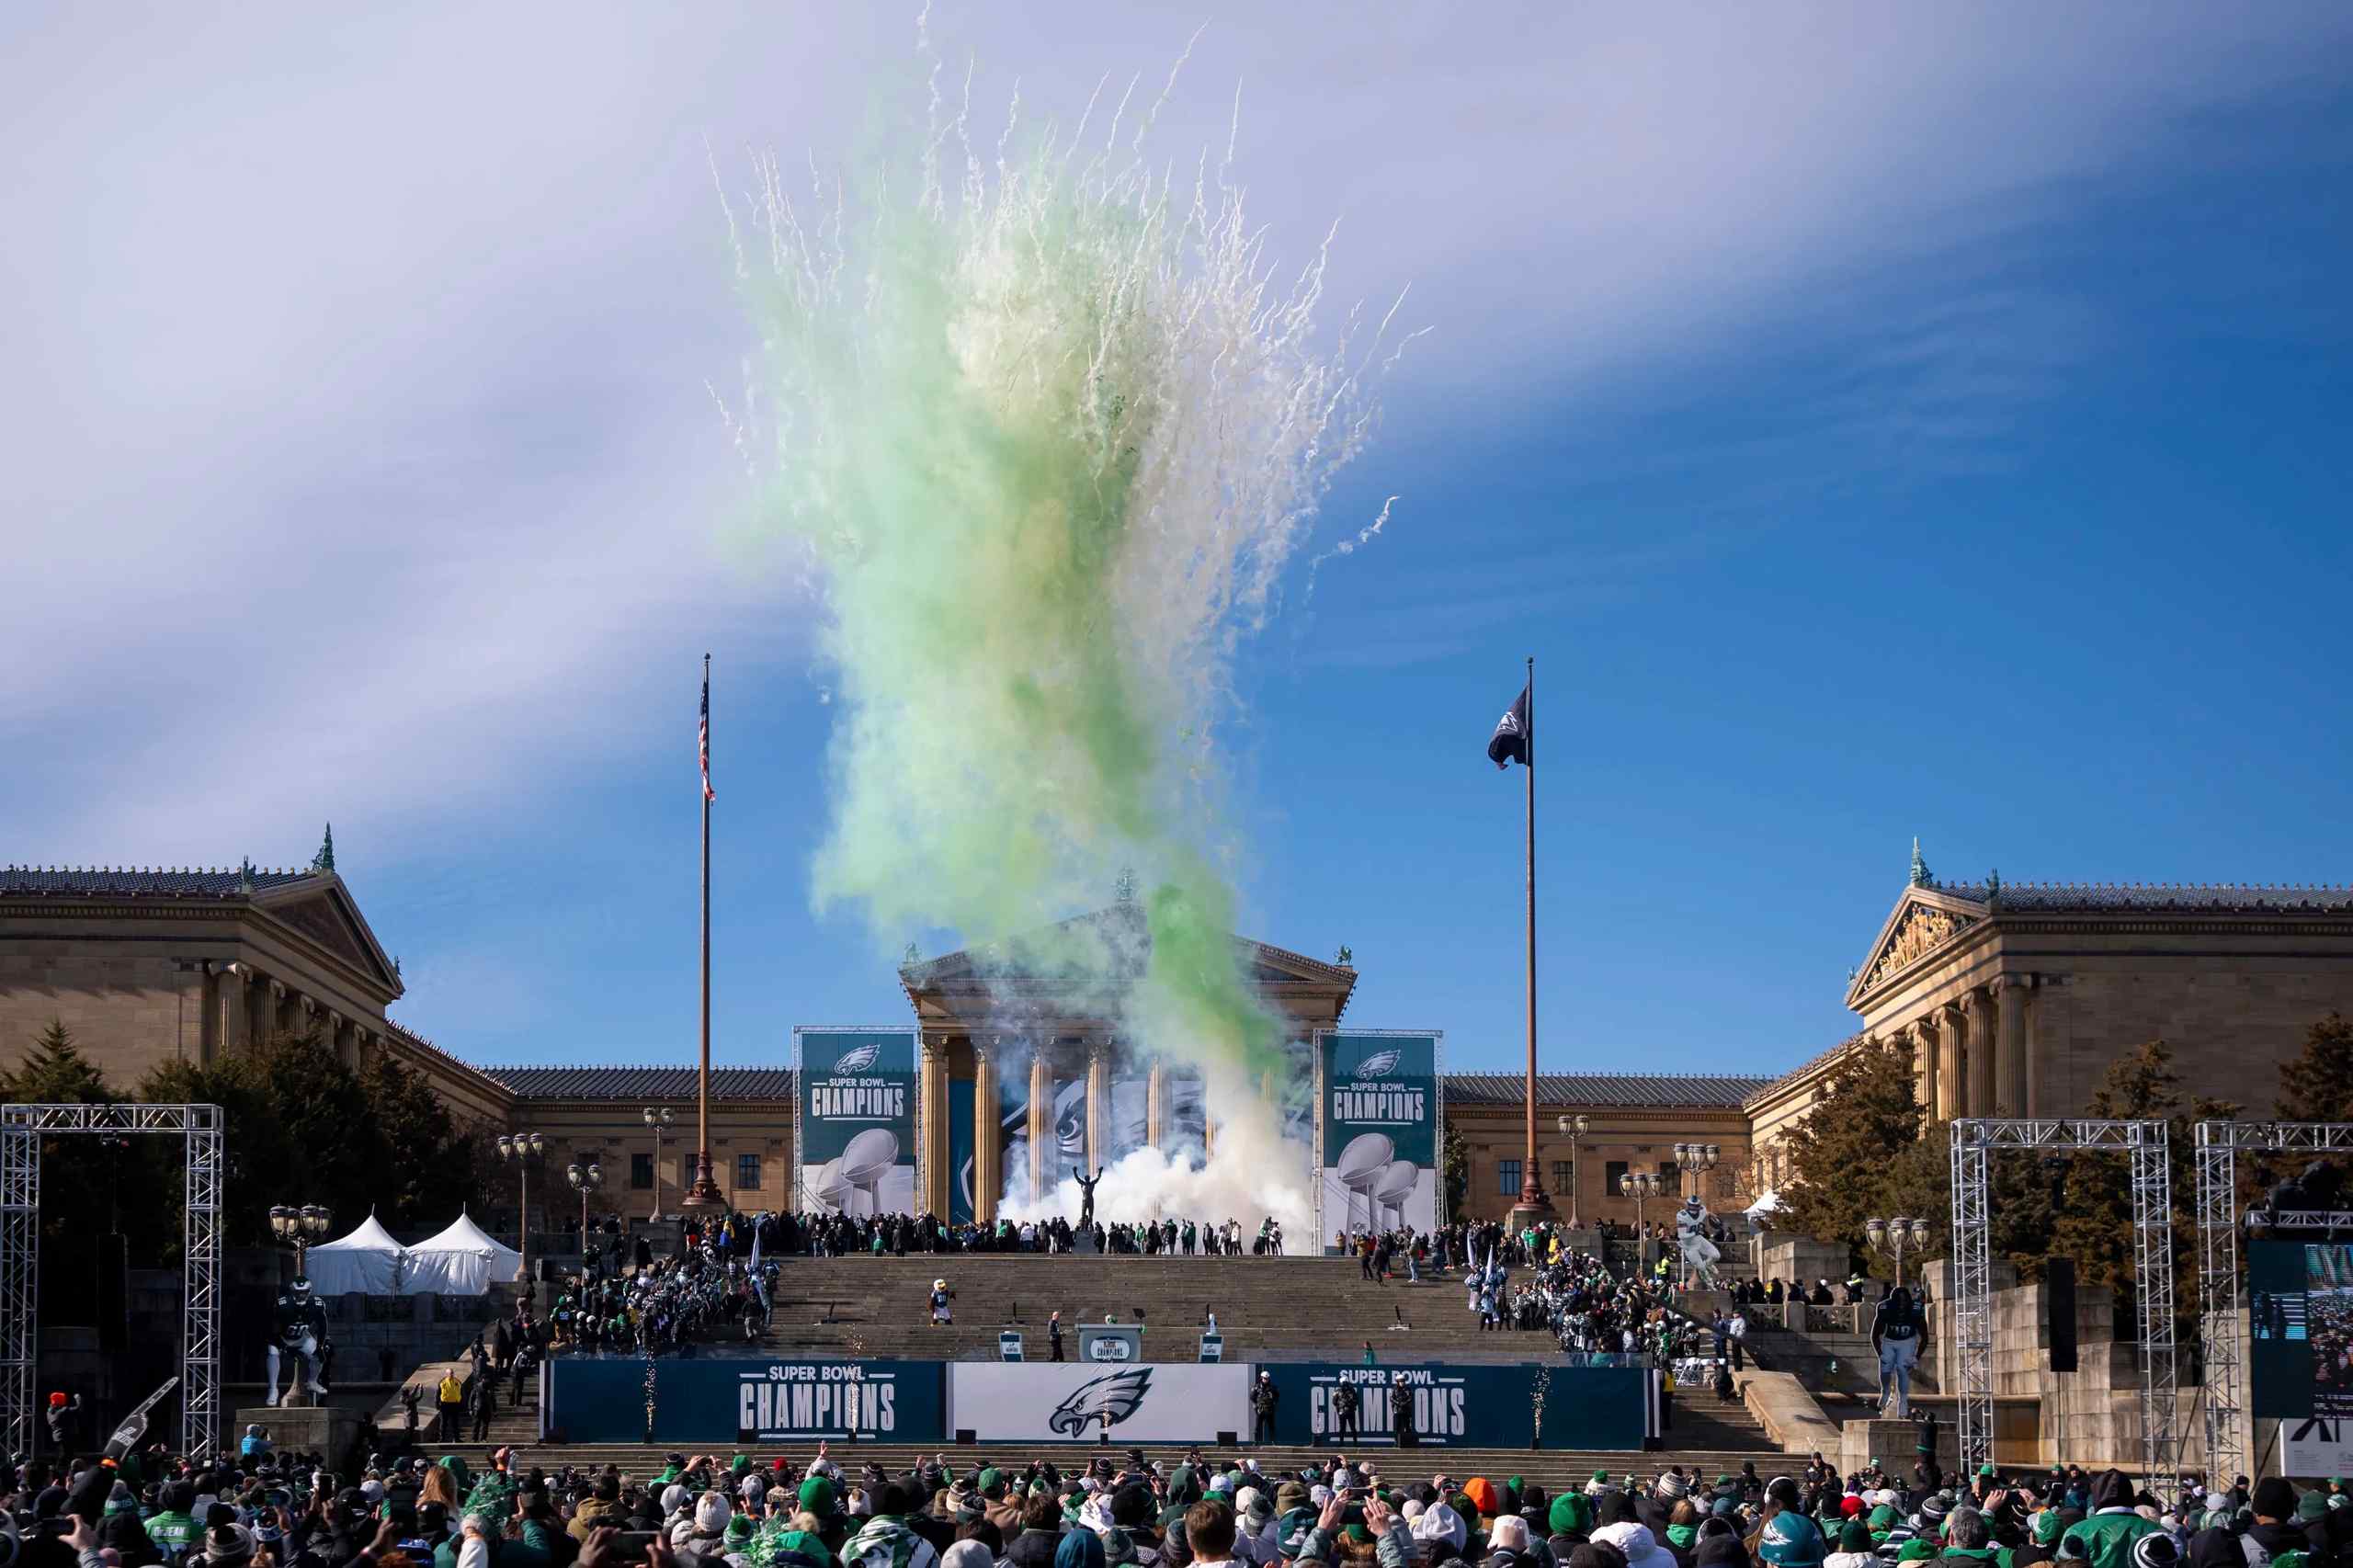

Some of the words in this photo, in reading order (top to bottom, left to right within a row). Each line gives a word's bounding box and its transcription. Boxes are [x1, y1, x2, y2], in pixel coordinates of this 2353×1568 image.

[828, 1078, 857, 1086] SUPER
[859, 1078, 886, 1086] BOWL
[1350, 1083, 1379, 1092] SUPER
[1381, 1083, 1406, 1092] BOWL
[812, 1087, 904, 1117] CHAMPIONS
[1334, 1092, 1424, 1121] CHAMPIONS
[769, 1366, 816, 1381] SUPER
[822, 1366, 866, 1381] BOWL
[740, 1382, 895, 1431] CHAMPIONS
[1311, 1386, 1465, 1436] CHMONS
